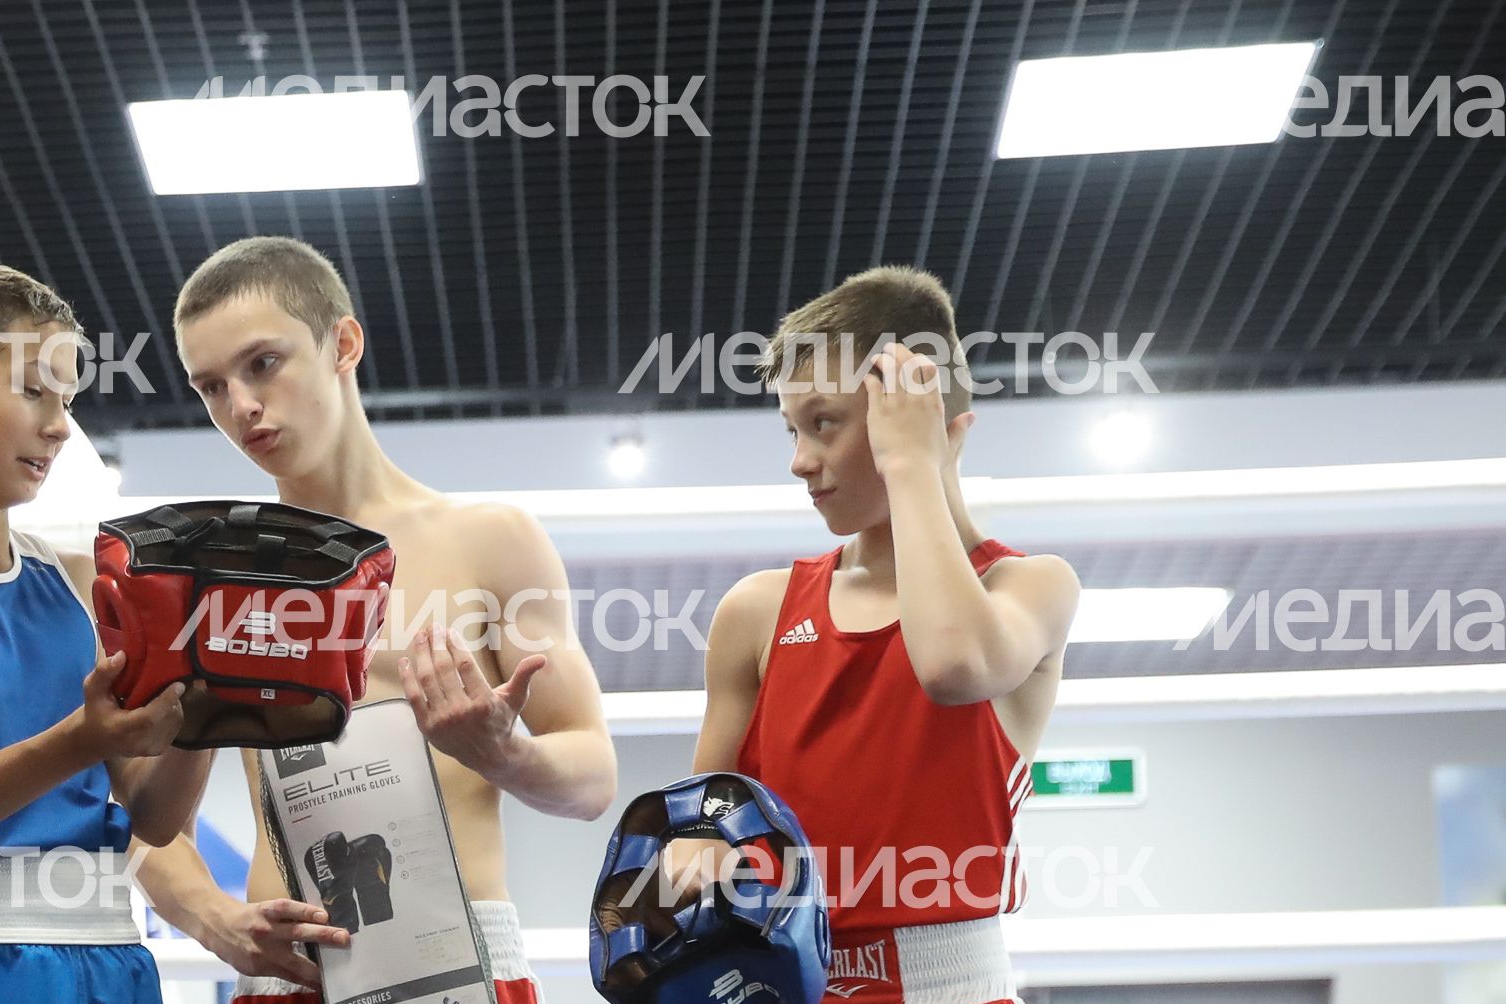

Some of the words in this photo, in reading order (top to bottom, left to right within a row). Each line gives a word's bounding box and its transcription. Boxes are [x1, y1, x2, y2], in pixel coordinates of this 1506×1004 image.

[262, 689, 274, 698] XL
[283, 758, 392, 802] ELITE
[288, 793, 327, 815] PROSTYLE
[329, 784, 367, 801] TRAINING
[369, 775, 401, 791] GLOVES
[827, 939, 890, 982] RLAST
